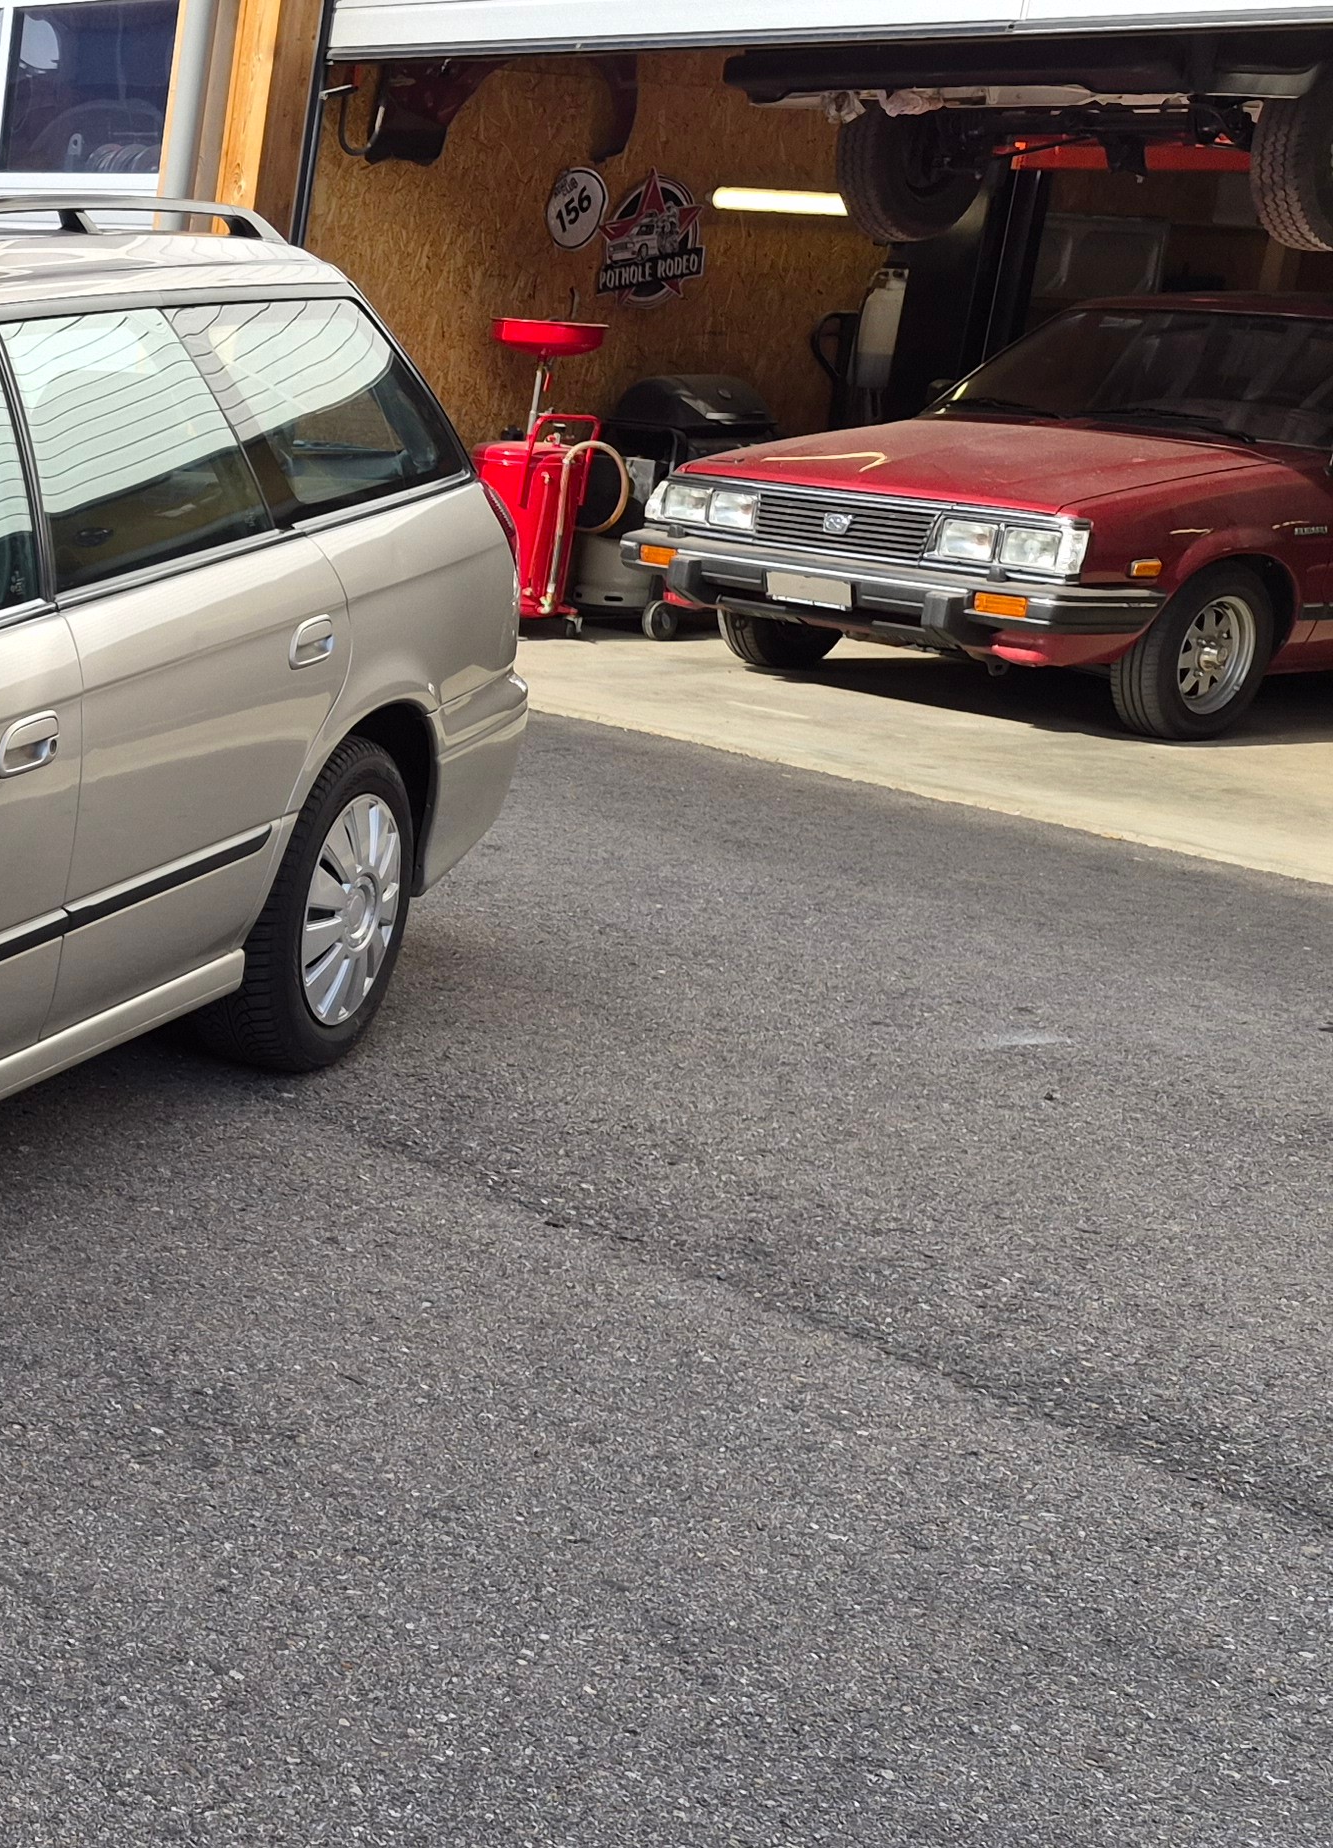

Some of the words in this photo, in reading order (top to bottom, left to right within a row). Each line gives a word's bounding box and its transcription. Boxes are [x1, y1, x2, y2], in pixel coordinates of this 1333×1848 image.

[556, 185, 591, 233] 156
[600, 263, 652, 290] POTHOLE
[658, 254, 698, 277] RODEO
